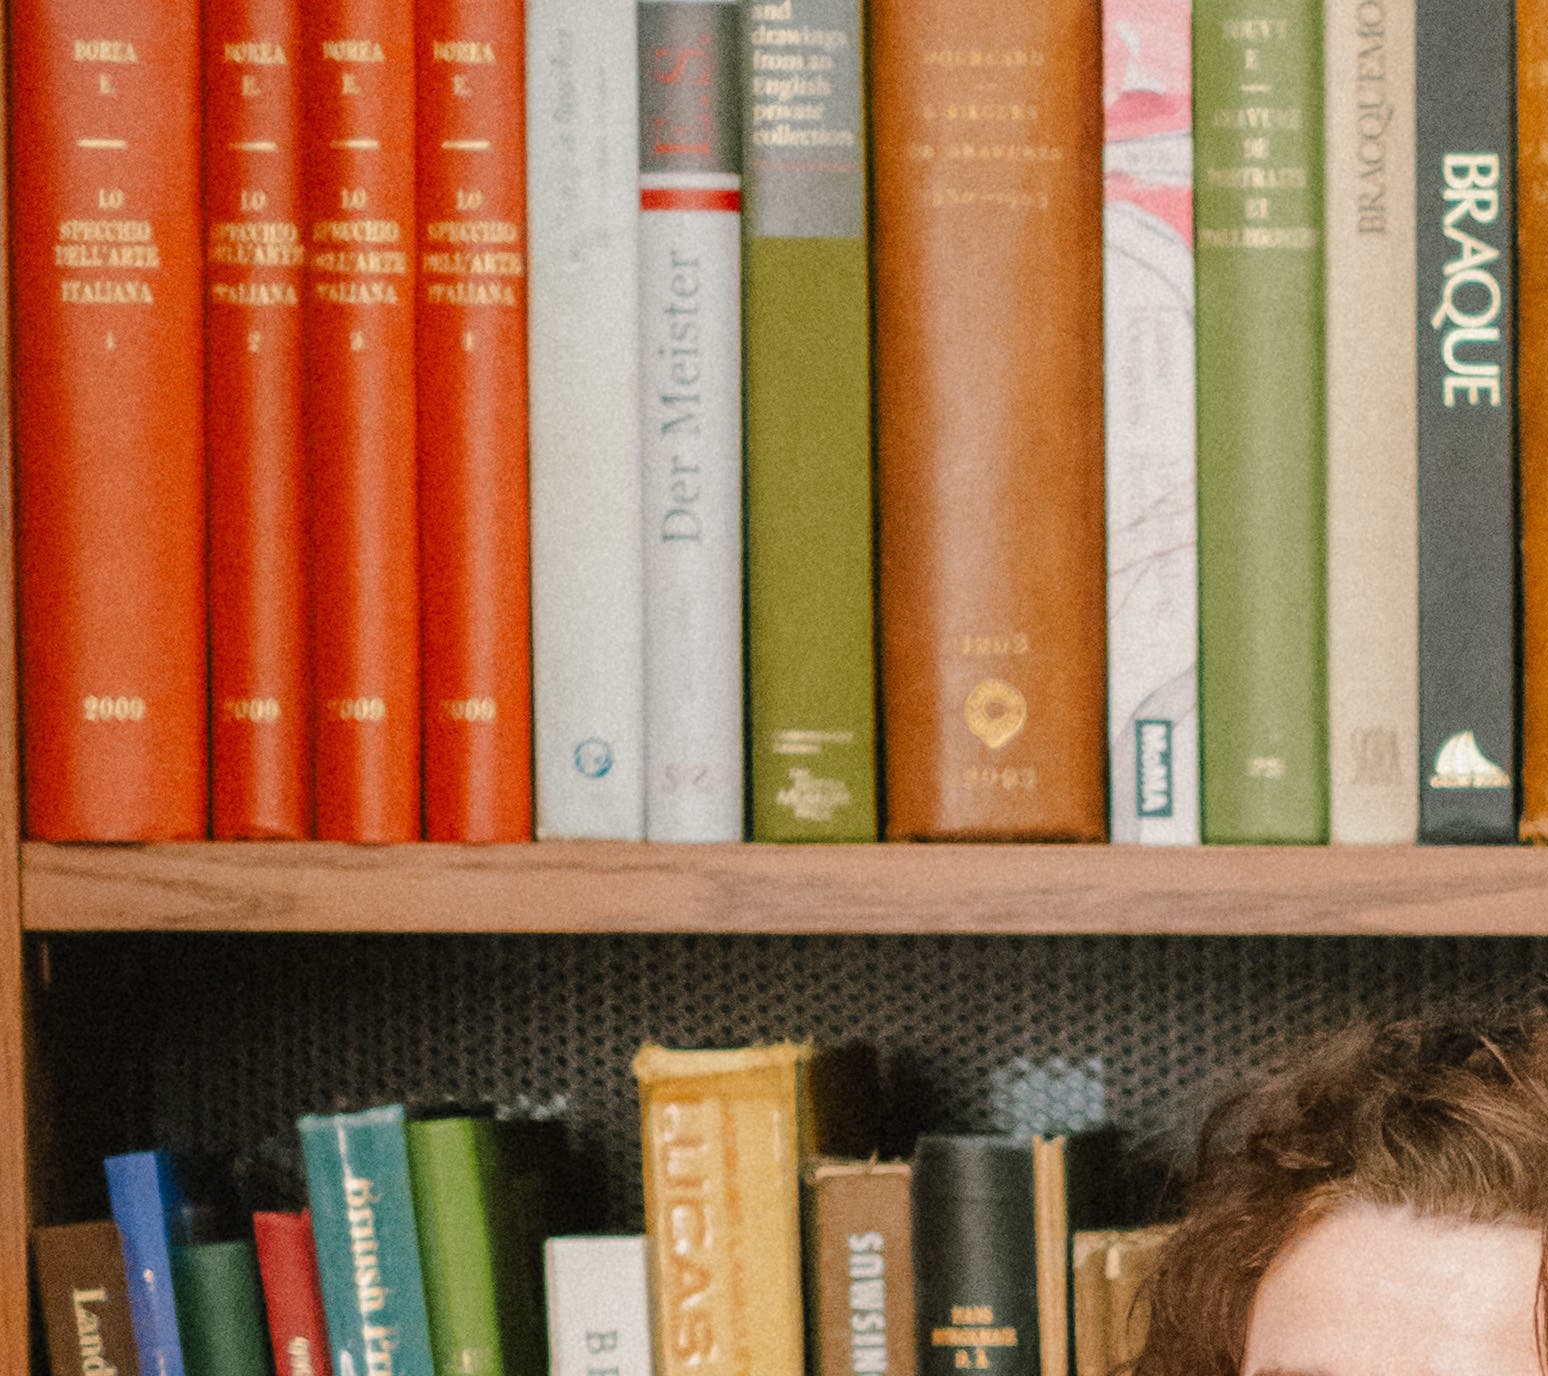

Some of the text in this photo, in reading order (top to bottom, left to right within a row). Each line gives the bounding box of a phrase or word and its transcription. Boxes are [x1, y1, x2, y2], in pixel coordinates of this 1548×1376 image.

[73, 41, 138, 63] BOREA
[753, 76, 831, 101] English
[752, 124, 854, 147] collection
[99, 188, 124, 209] LO
[1431, 153, 1501, 407] BRAQUE
[61, 282, 154, 304] ITALIANA
[660, 249, 701, 545] Der Meister
[84, 696, 145, 720] 2000
[660, 1104, 722, 1370] LUCAS
